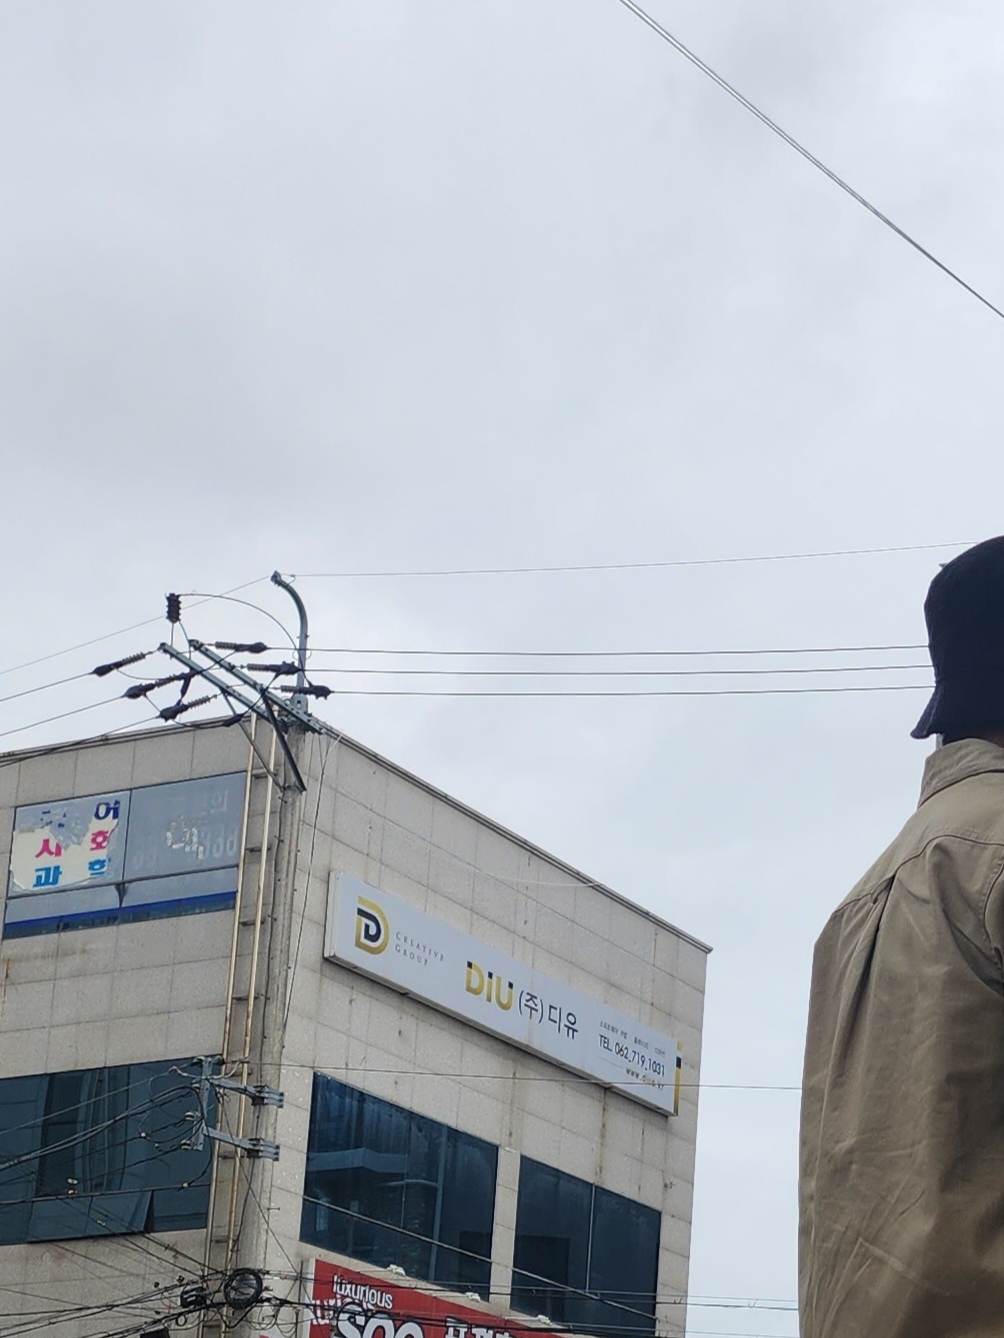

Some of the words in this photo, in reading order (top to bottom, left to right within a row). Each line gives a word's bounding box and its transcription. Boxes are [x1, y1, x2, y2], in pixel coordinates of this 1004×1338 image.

[395, 931, 444, 962] CREATIVE
[395, 944, 428, 966] GROUP
[333, 1275, 393, 1309] luxurious
